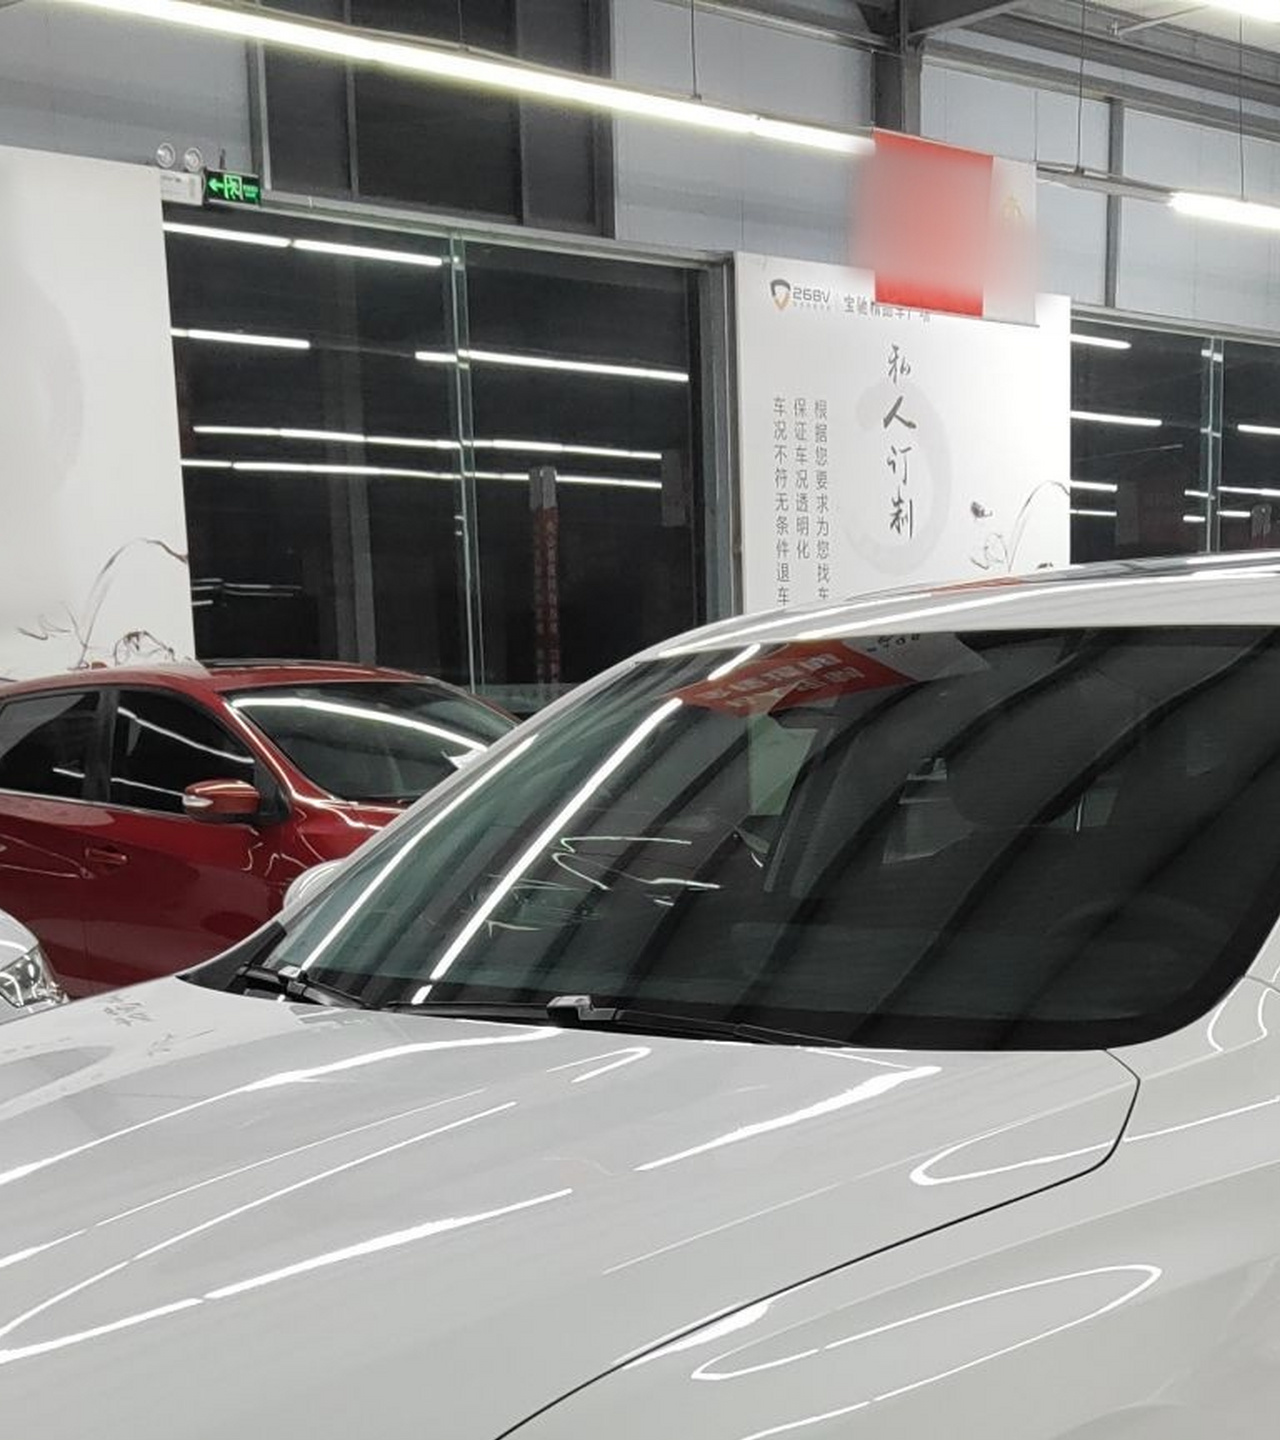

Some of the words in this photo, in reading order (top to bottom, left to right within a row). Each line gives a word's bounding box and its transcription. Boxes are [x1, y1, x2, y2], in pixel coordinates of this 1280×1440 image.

[773, 397, 791, 606] 车况不符无条件退车
[793, 398, 810, 560] 保证车况透明化
